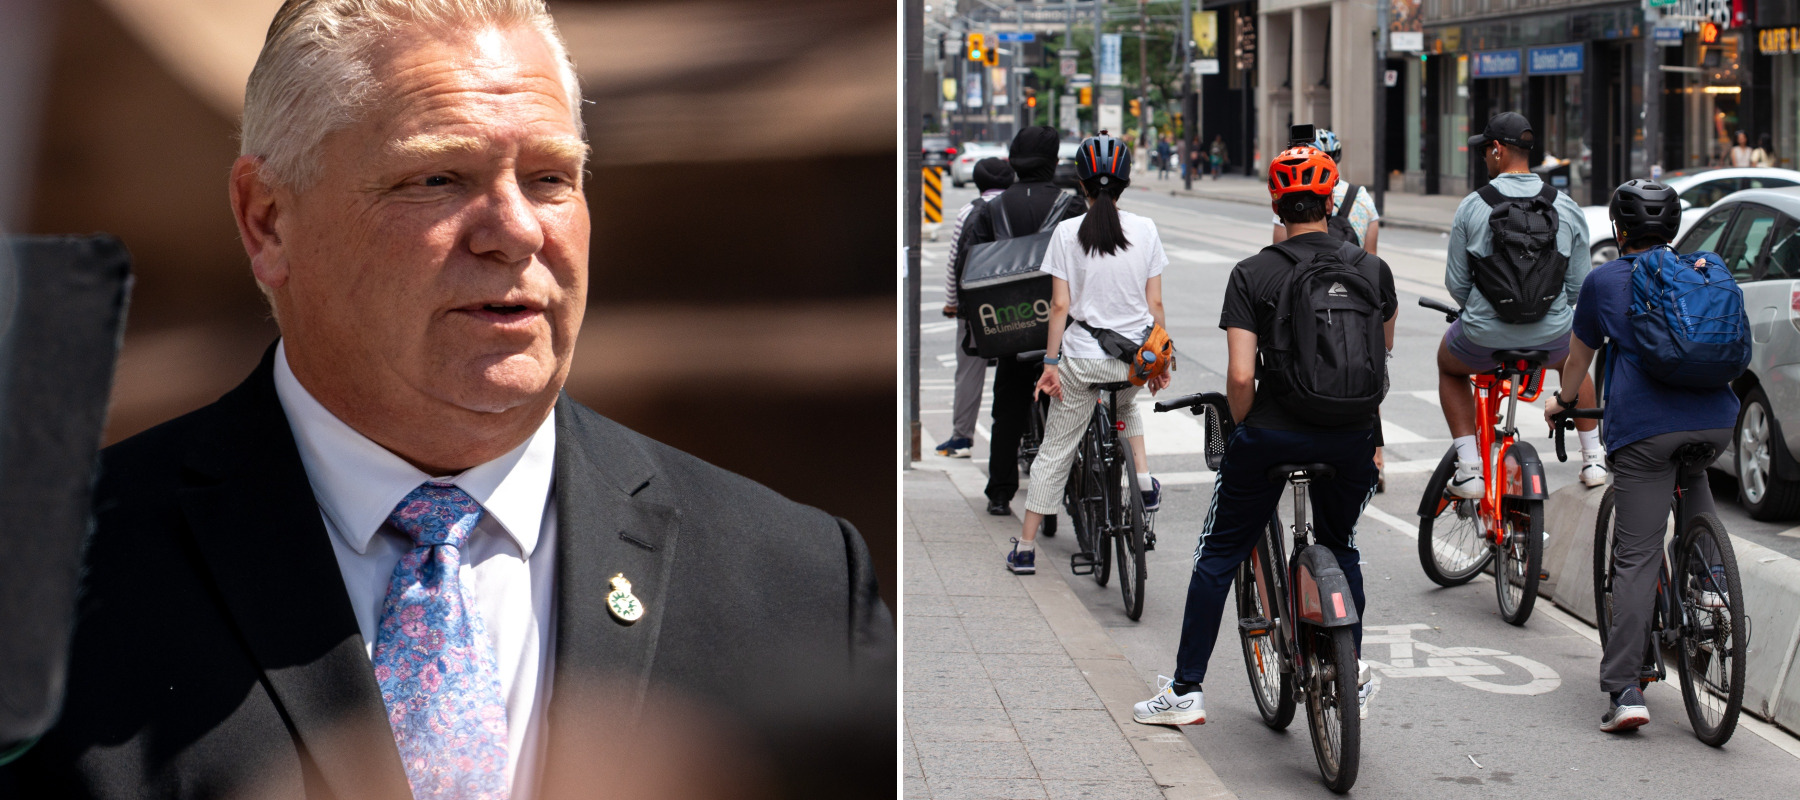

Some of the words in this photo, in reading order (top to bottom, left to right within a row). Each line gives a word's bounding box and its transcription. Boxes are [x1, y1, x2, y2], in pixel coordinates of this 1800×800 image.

[1790, 27, 1800, 53] L
[979, 299, 1053, 327] Ameg
[1265, 520, 1279, 584] angerine
